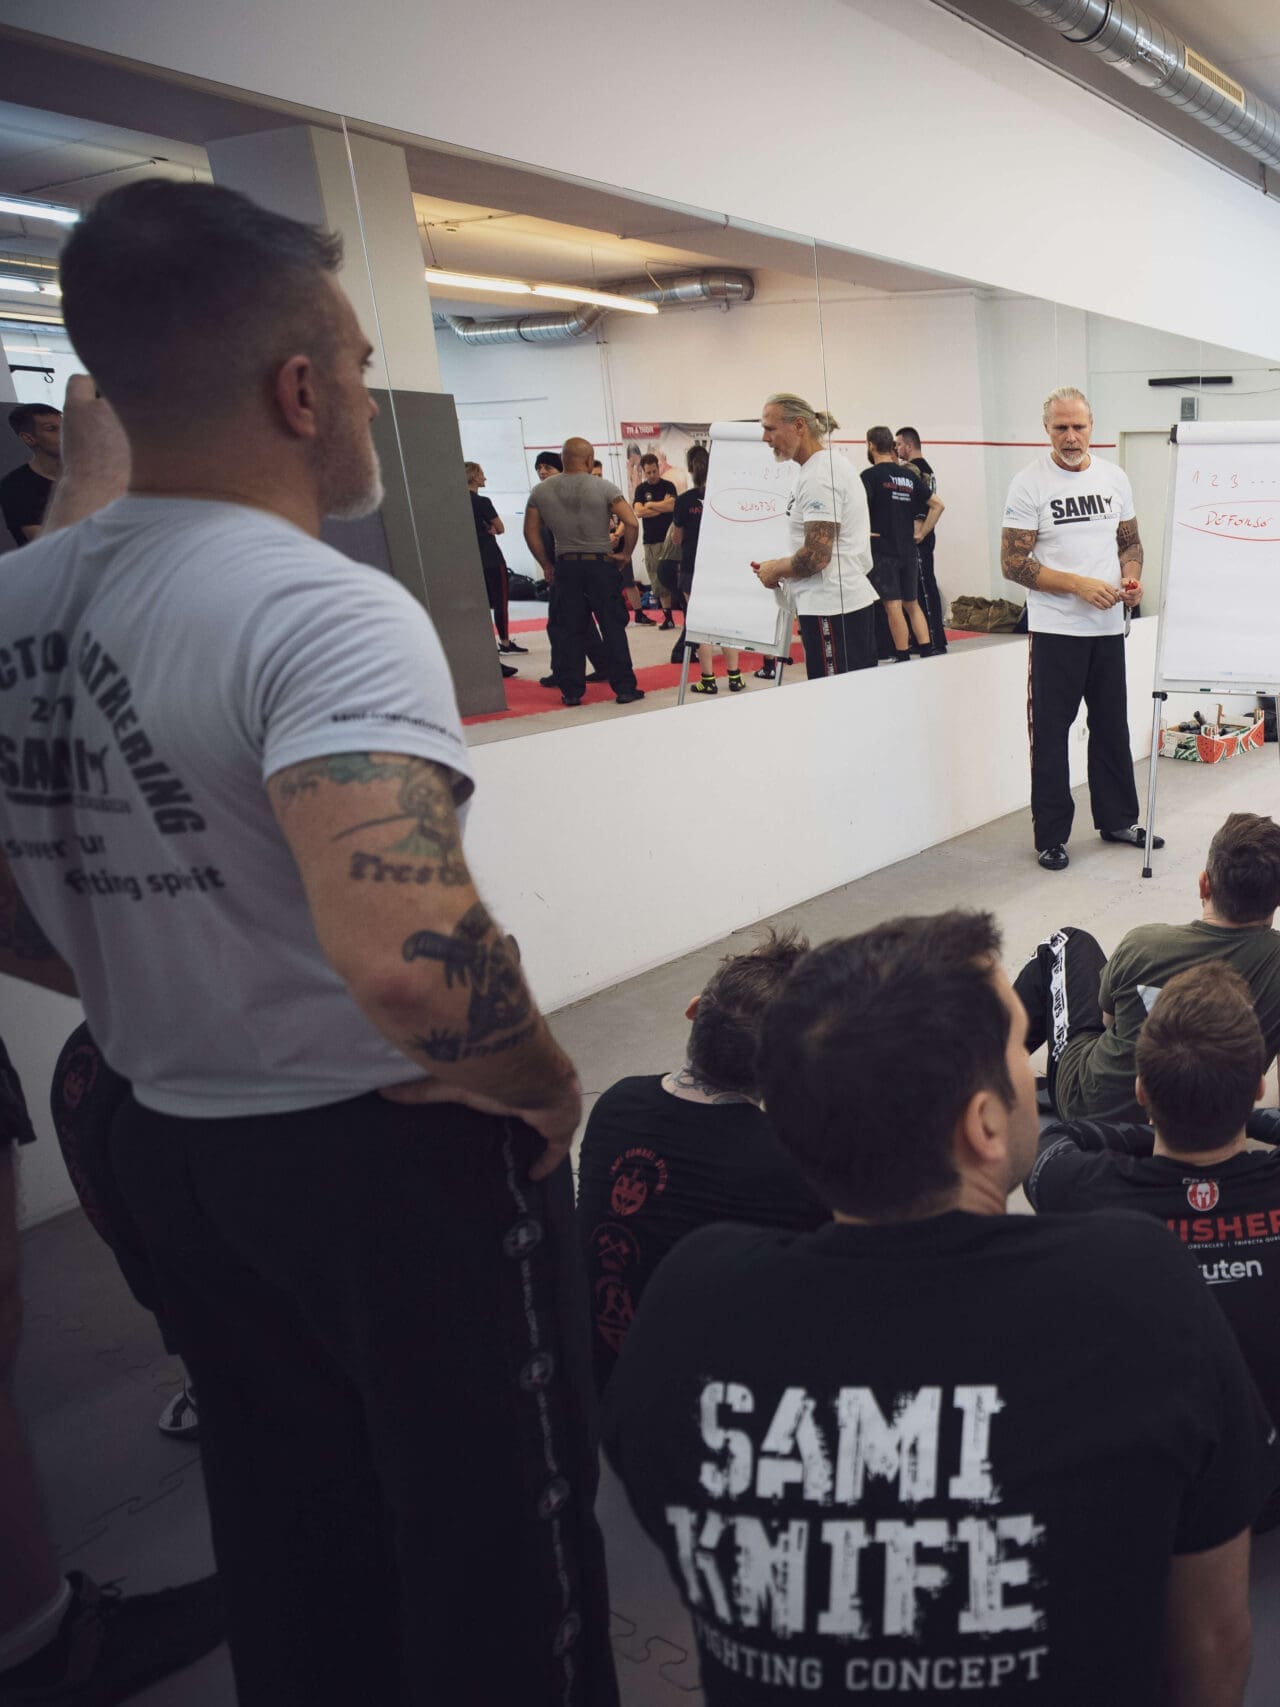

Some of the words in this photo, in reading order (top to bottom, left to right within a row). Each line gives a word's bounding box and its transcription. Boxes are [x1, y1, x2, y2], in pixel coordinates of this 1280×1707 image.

[1209, 473, 1219, 487] 2
[1230, 472, 1239, 489] 3
[1050, 494, 1105, 519] SAMI
[1199, 1259, 1263, 1280] uten
[698, 1381, 1005, 1506] SAMI
[664, 1506, 1048, 1641] KNIFE
[846, 1646, 1049, 1691] CONCEPT
